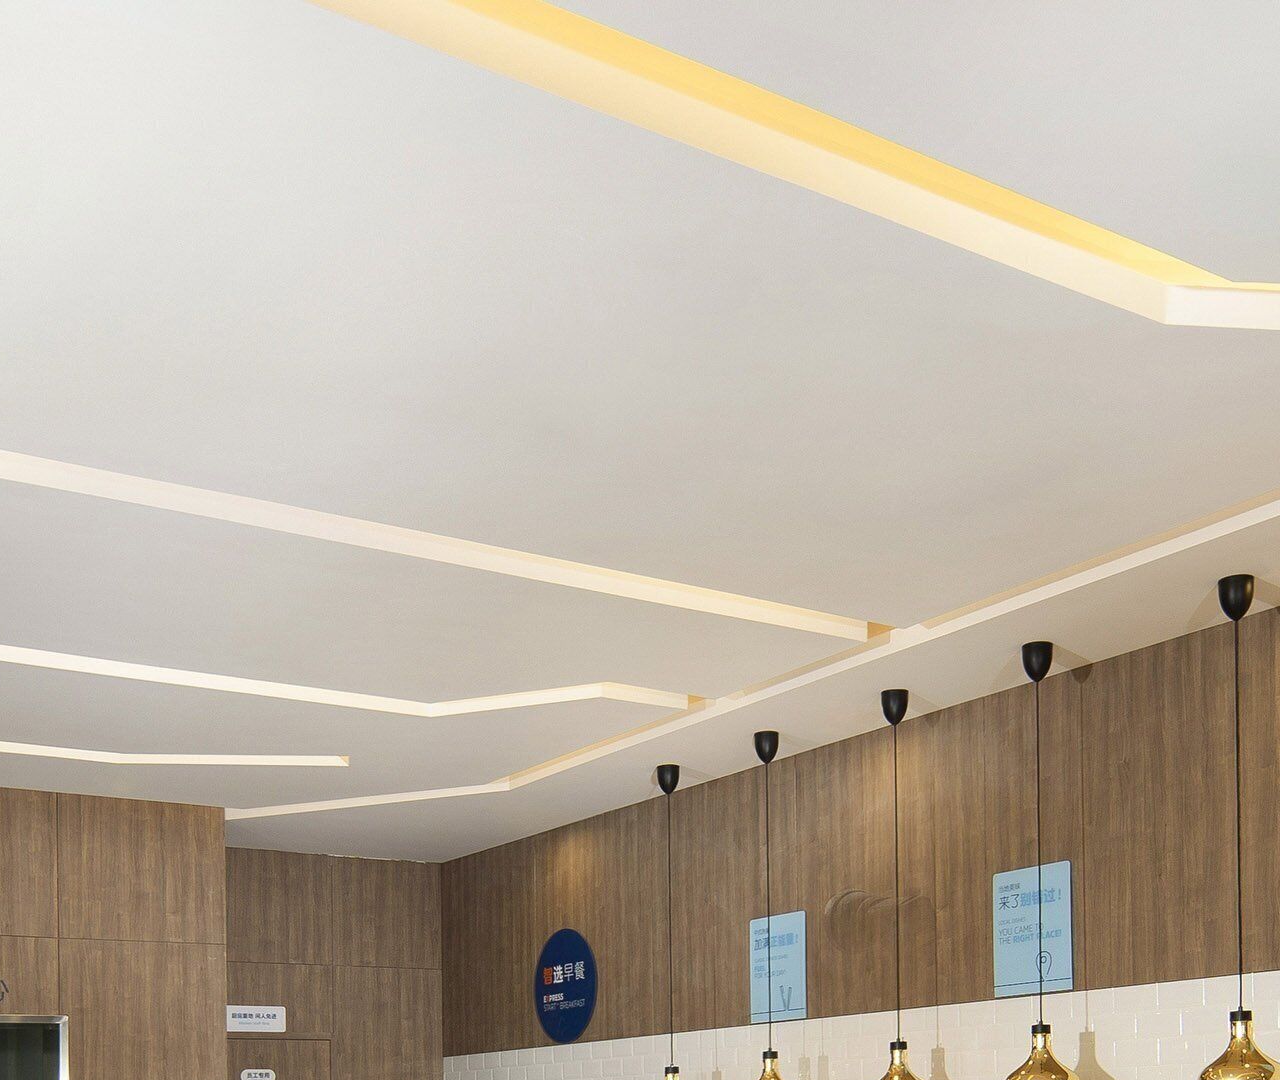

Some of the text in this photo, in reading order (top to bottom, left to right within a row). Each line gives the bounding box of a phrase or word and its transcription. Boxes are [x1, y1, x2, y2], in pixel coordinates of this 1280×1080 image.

[1014, 924, 1033, 935] CAME
[999, 936, 1011, 945] THE
[1013, 932, 1034, 944] RIGHT
[543, 961, 586, 985] 智选早餐
